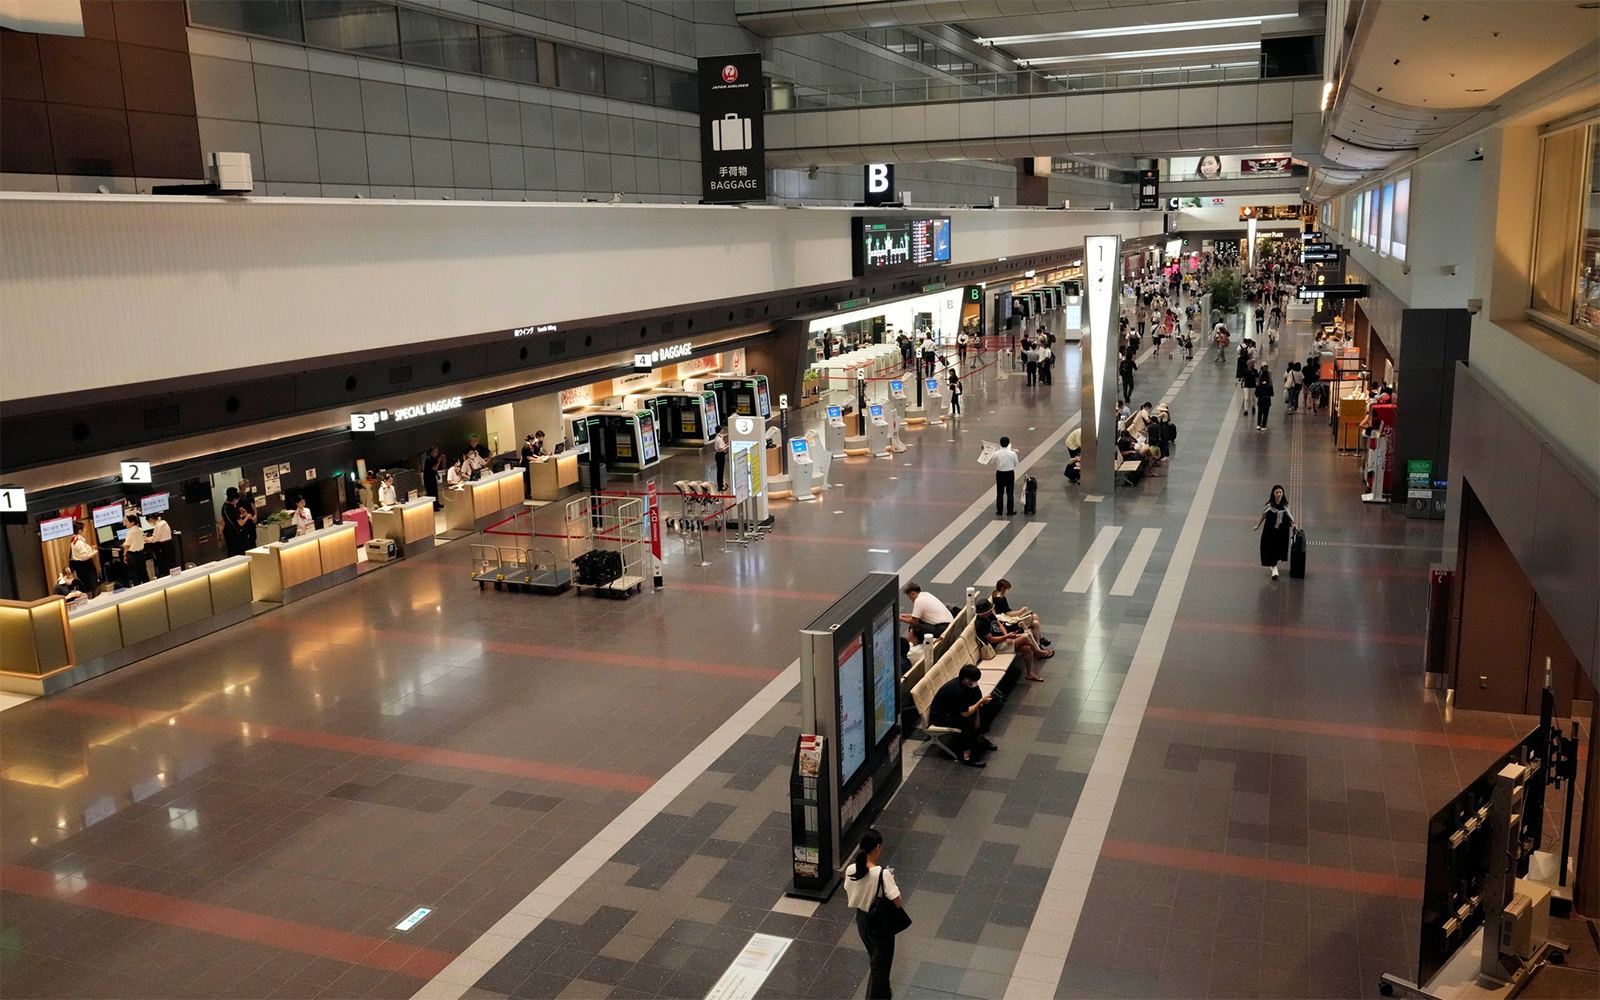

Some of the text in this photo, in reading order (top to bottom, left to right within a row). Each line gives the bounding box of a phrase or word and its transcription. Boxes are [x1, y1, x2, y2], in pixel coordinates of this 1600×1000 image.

[719, 166, 748, 177] 手荷物
[868, 163, 889, 193] B
[710, 179, 758, 190] BAGGAGE
[1169, 197, 1178, 207] C
[971, 288, 979, 300] B
[946, 300, 953, 309] B
[639, 342, 693, 365] 4 BAGGAGE
[357, 396, 462, 429] 3 SPECIAL BAGGAGE
[741, 420, 748, 432] 3
[128, 464, 140, 480] 2
[2, 491, 12, 509] 1
